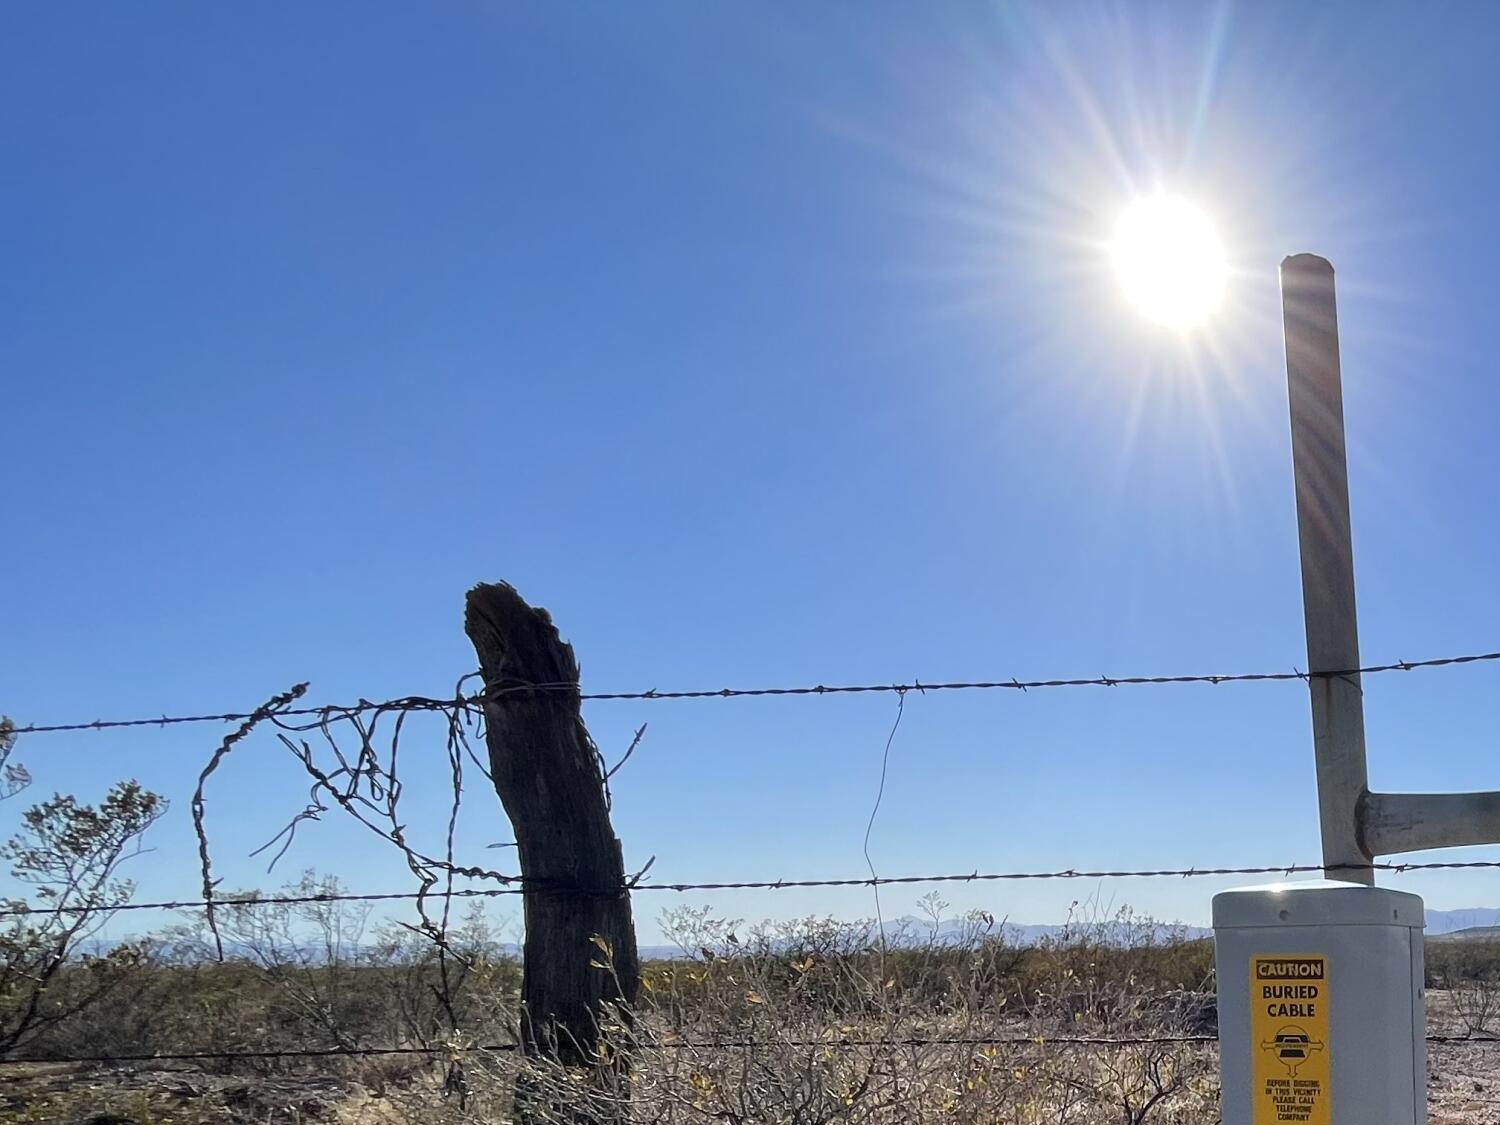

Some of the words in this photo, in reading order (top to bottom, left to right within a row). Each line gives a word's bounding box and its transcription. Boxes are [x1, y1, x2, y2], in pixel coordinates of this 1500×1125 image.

[1258, 963, 1322, 977] CAUTION
[1263, 985, 1319, 999] BURIED
[1267, 1003, 1316, 1017] CABLE
[1266, 1079, 1290, 1087] BEFORE
[1293, 1088, 1321, 1096] VICINITY
[1273, 1096, 1296, 1104] PLEASE
[1298, 1096, 1315, 1104] CALL
[1276, 1104, 1312, 1113] TELEPHONE
[1278, 1113, 1310, 1121] COMPANY
